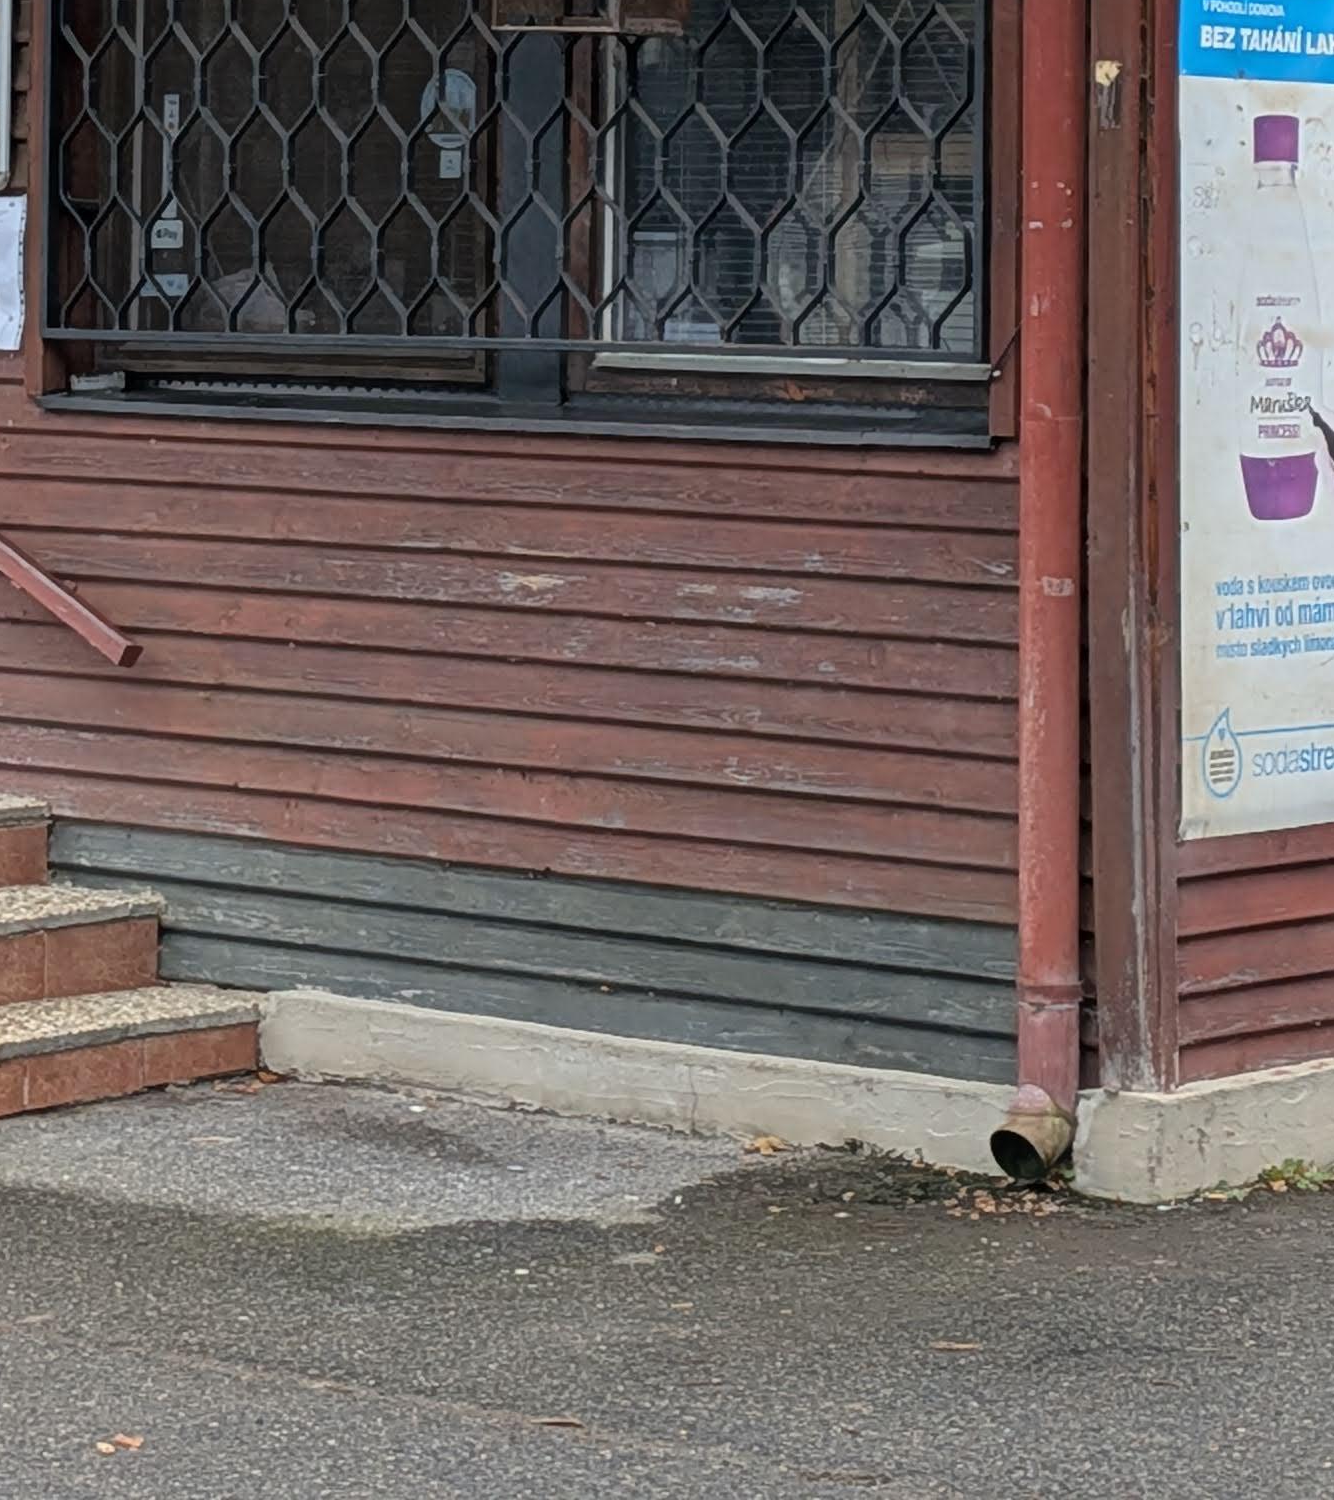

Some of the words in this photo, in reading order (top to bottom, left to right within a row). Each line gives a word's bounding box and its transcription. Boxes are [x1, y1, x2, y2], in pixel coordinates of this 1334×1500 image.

[1200, 24, 1236, 49] BEZ
[1240, 25, 1304, 54] TAHÁNÍ
[1215, 576, 1244, 596] voda
[1246, 578, 1255, 595] s
[1274, 599, 1294, 627] od
